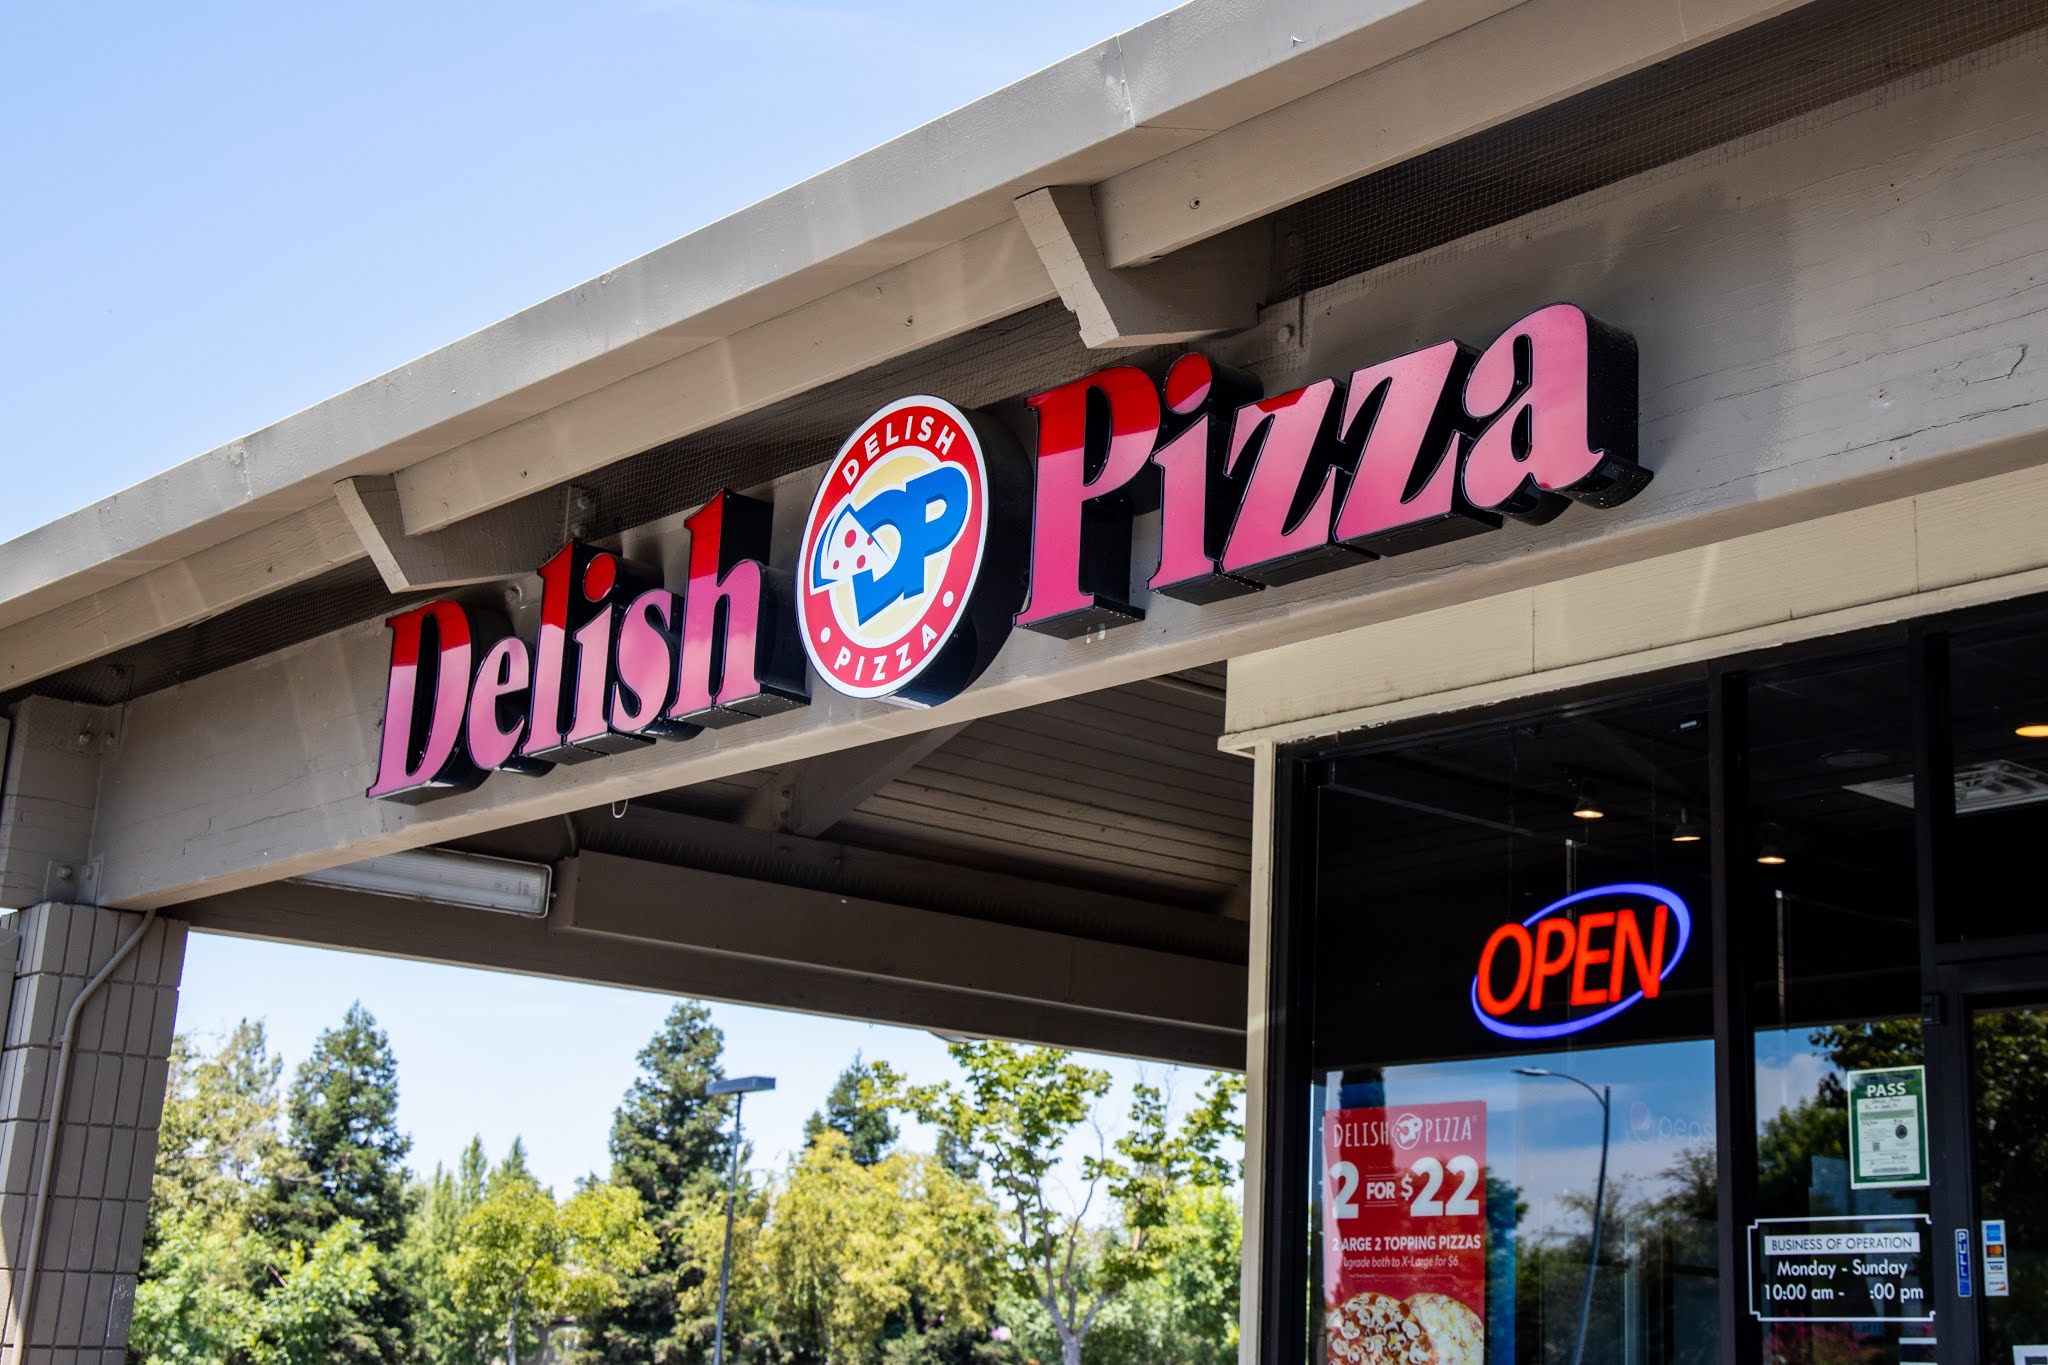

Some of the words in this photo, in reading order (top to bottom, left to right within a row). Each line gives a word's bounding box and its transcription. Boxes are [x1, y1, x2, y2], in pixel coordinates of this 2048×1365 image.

[842, 415, 956, 486] DELISH
[366, 488, 762, 798] Delish
[1012, 302, 1605, 629] Pizza
[833, 623, 938, 682] PIZZA
[1477, 904, 1669, 1016] OPEN
[1866, 1082, 1907, 1098] PASS
[1333, 1121, 1389, 1148] DELISH
[1425, 1116, 1472, 1143] PIZZA
[1328, 1160, 1360, 1219] 2
[1366, 1181, 1396, 1200] FOR
[1374, 1237, 1382, 1251] 2
[1383, 1235, 1436, 1251] TOPPING
[1438, 1234, 1481, 1250] PIZZAS
[1771, 1238, 1823, 1251] BUSINESS
[1826, 1237, 1843, 1250] OF
[1846, 1236, 1913, 1249] OPERATION
[1958, 1232, 1968, 1277] PULL
[1371, 1256, 1390, 1267] both
[1391, 1257, 1400, 1267] to
[1401, 1256, 1434, 1269] X-Large
[1434, 1255, 1446, 1267] for
[1447, 1255, 1459, 1267] $6
[1776, 1259, 1837, 1280] Monday
[1852, 1258, 1908, 1279] Sunday
[1764, 1283, 1807, 1300] 10:00
[1811, 1288, 1835, 1300] am
[1900, 1288, 1924, 1303] pm
